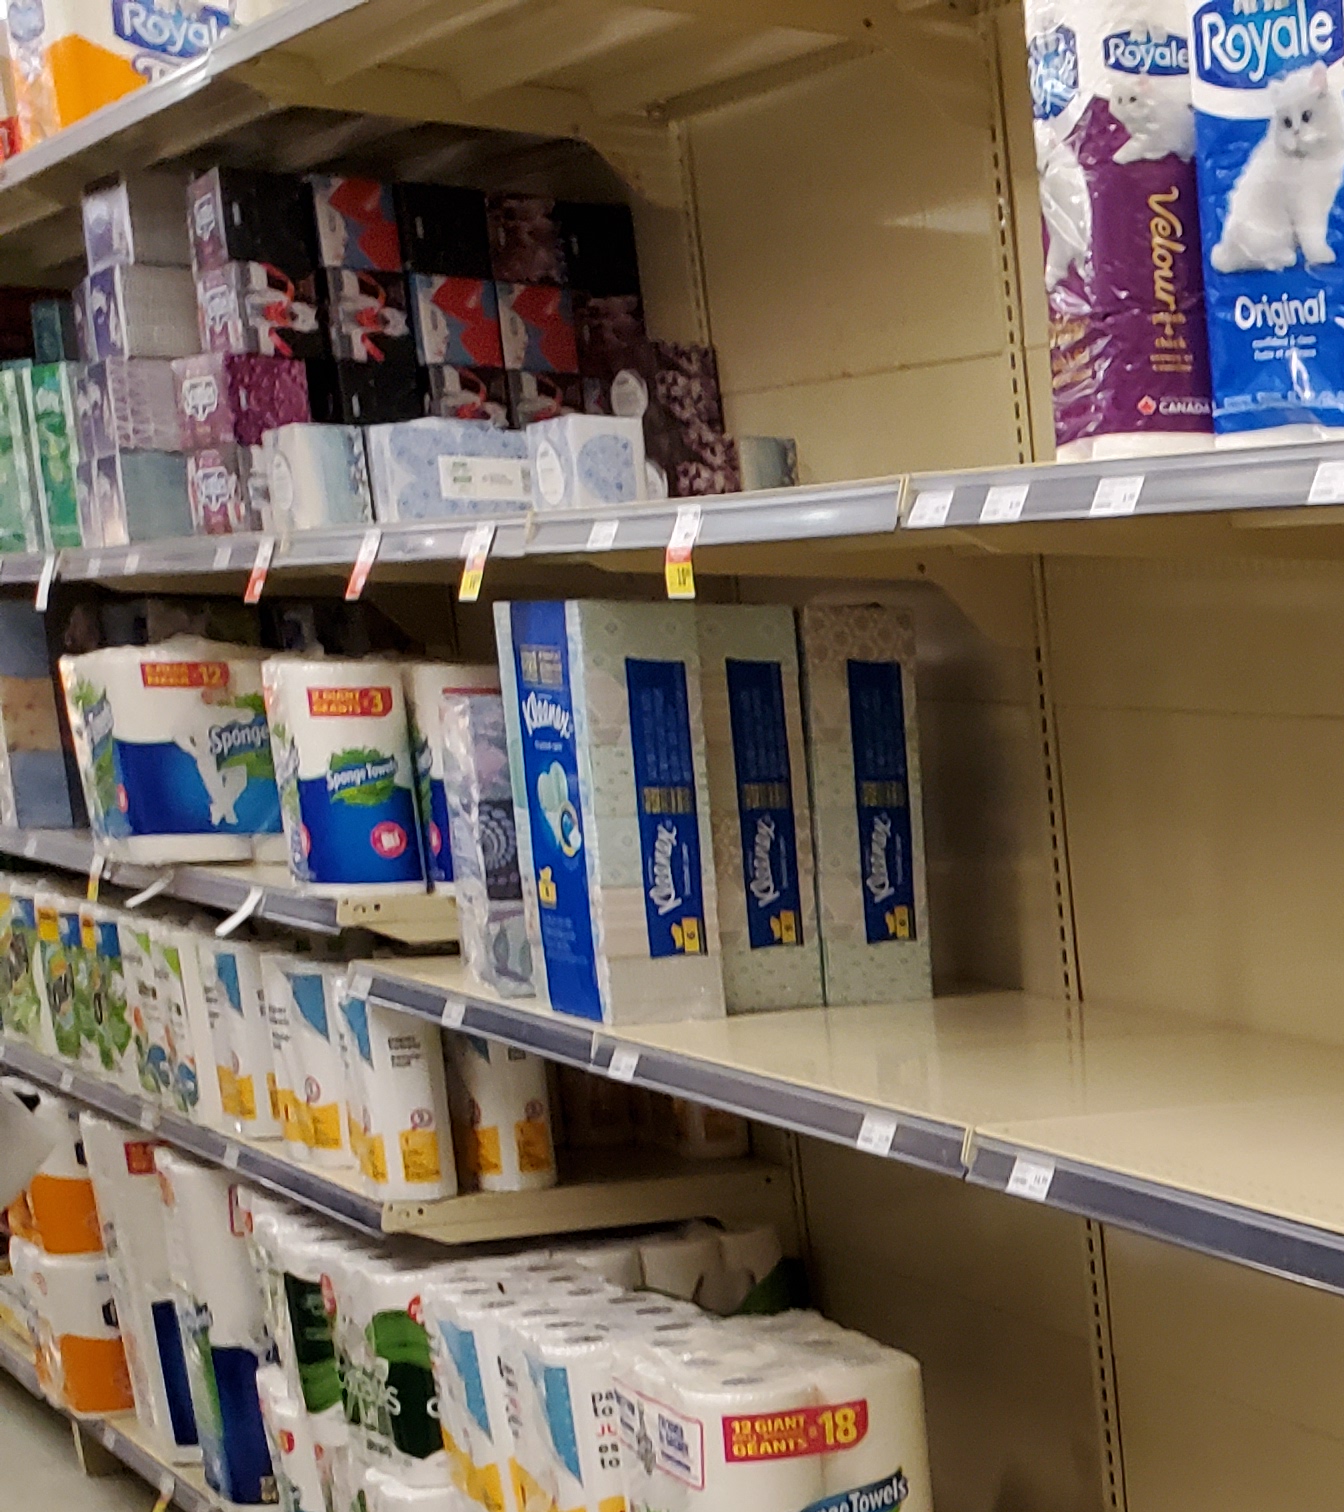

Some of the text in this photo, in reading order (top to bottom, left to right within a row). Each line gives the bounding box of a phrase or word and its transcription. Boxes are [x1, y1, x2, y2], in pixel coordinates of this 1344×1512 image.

[1108, 35, 1188, 68] Royale
[1201, 10, 1334, 80] Royale
[1147, 185, 1189, 310] Velour
[1233, 288, 1327, 336] Original
[1159, 401, 1212, 416] CANADA
[521, 690, 571, 740] Kleenex
[817, 1406, 858, 1446] 18
